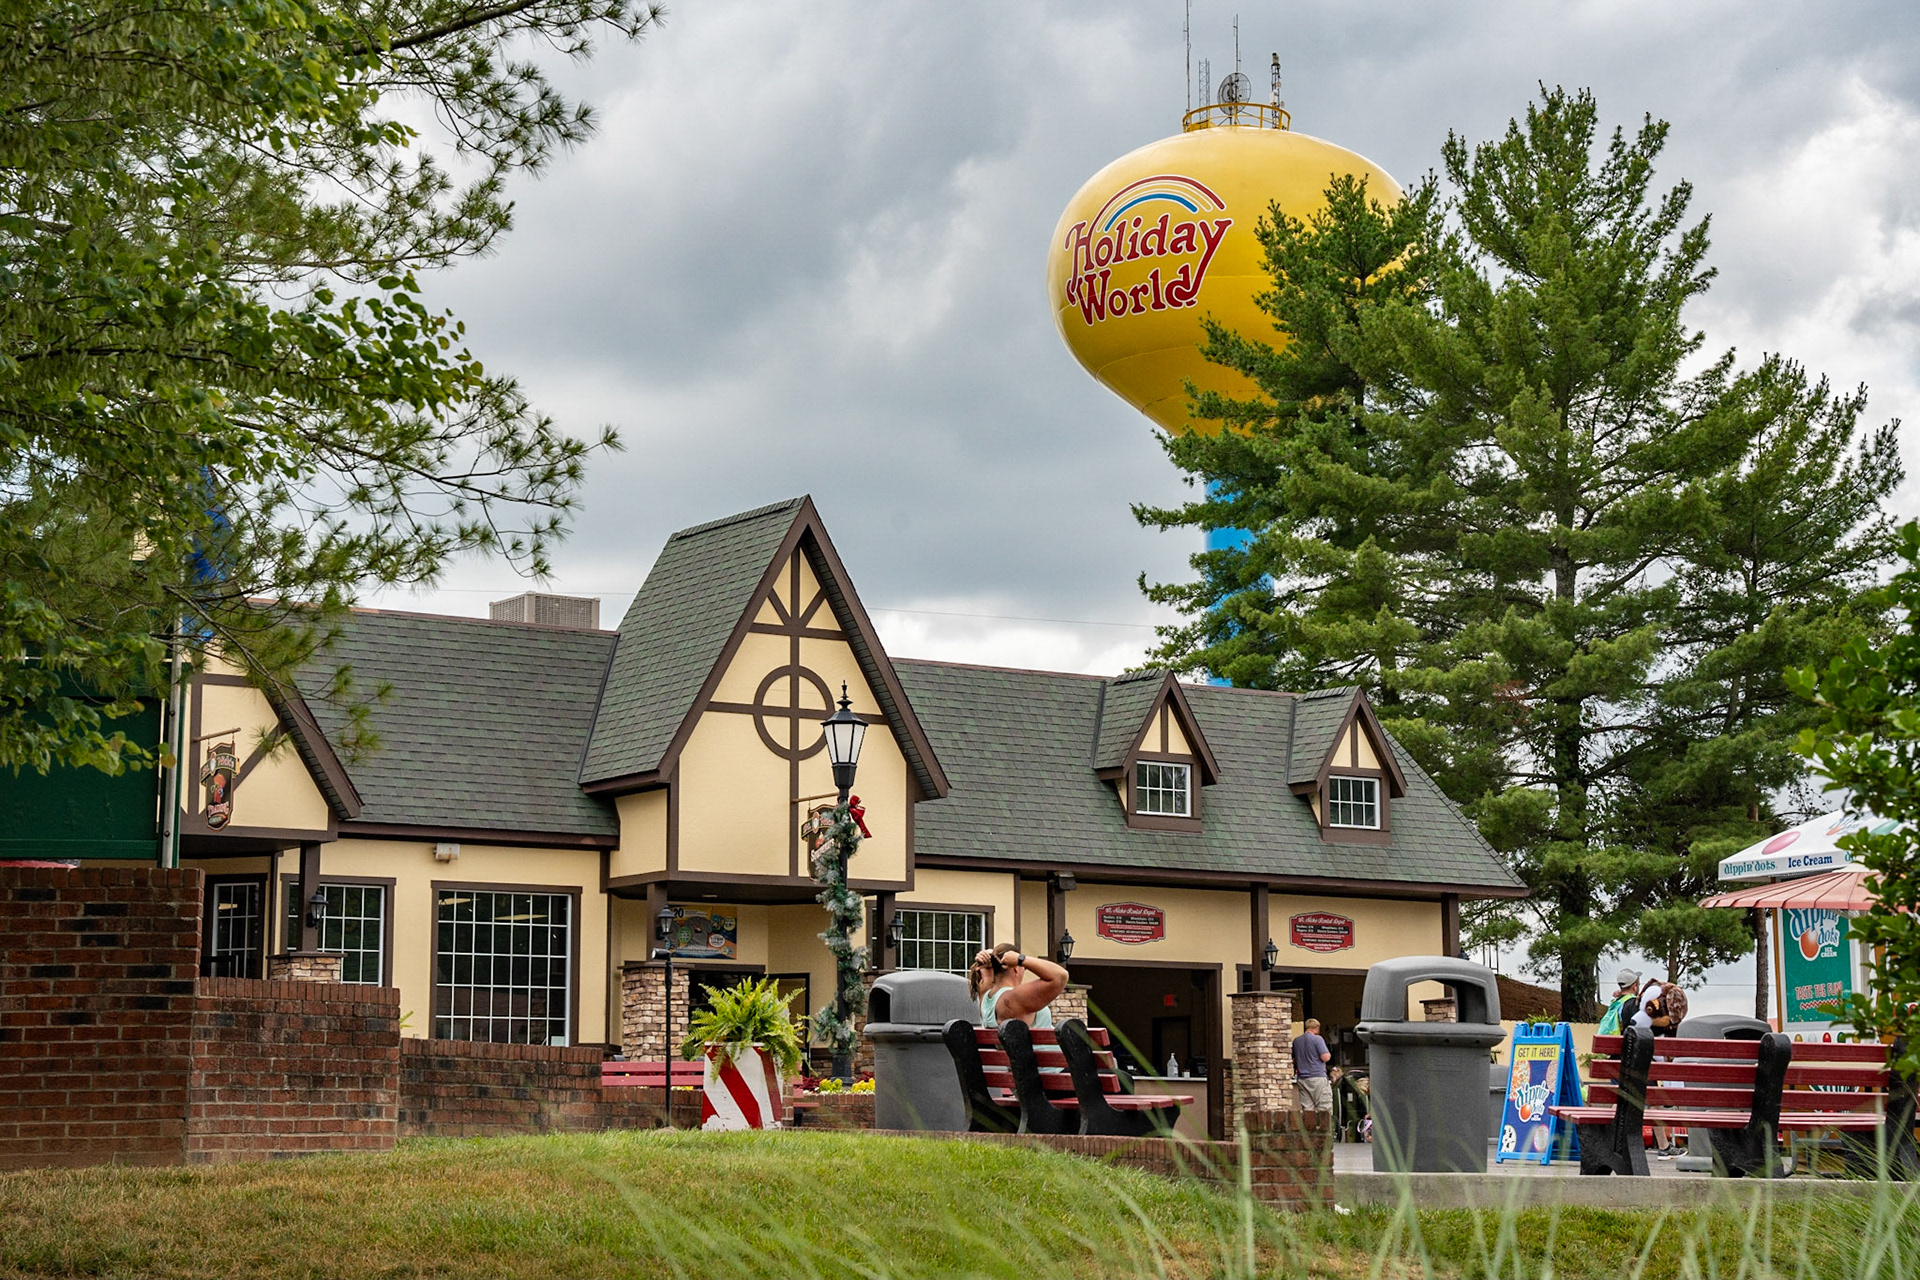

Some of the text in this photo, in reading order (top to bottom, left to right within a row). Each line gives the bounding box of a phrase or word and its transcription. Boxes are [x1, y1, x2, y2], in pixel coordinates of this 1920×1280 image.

[1065, 213, 1234, 298] Holiday
[1066, 263, 1199, 326] World
[1724, 860, 1754, 876] dippin'
[1755, 861, 1776, 872] dots
[1788, 857, 1801, 868] Ice
[1803, 855, 1833, 867] Cream
[1818, 927, 1839, 945] dots
[1795, 985, 1813, 1000] TASTE
[1814, 983, 1826, 998] THE
[1518, 1048, 1529, 1058] GET
[1539, 1047, 1556, 1058] HERE!
